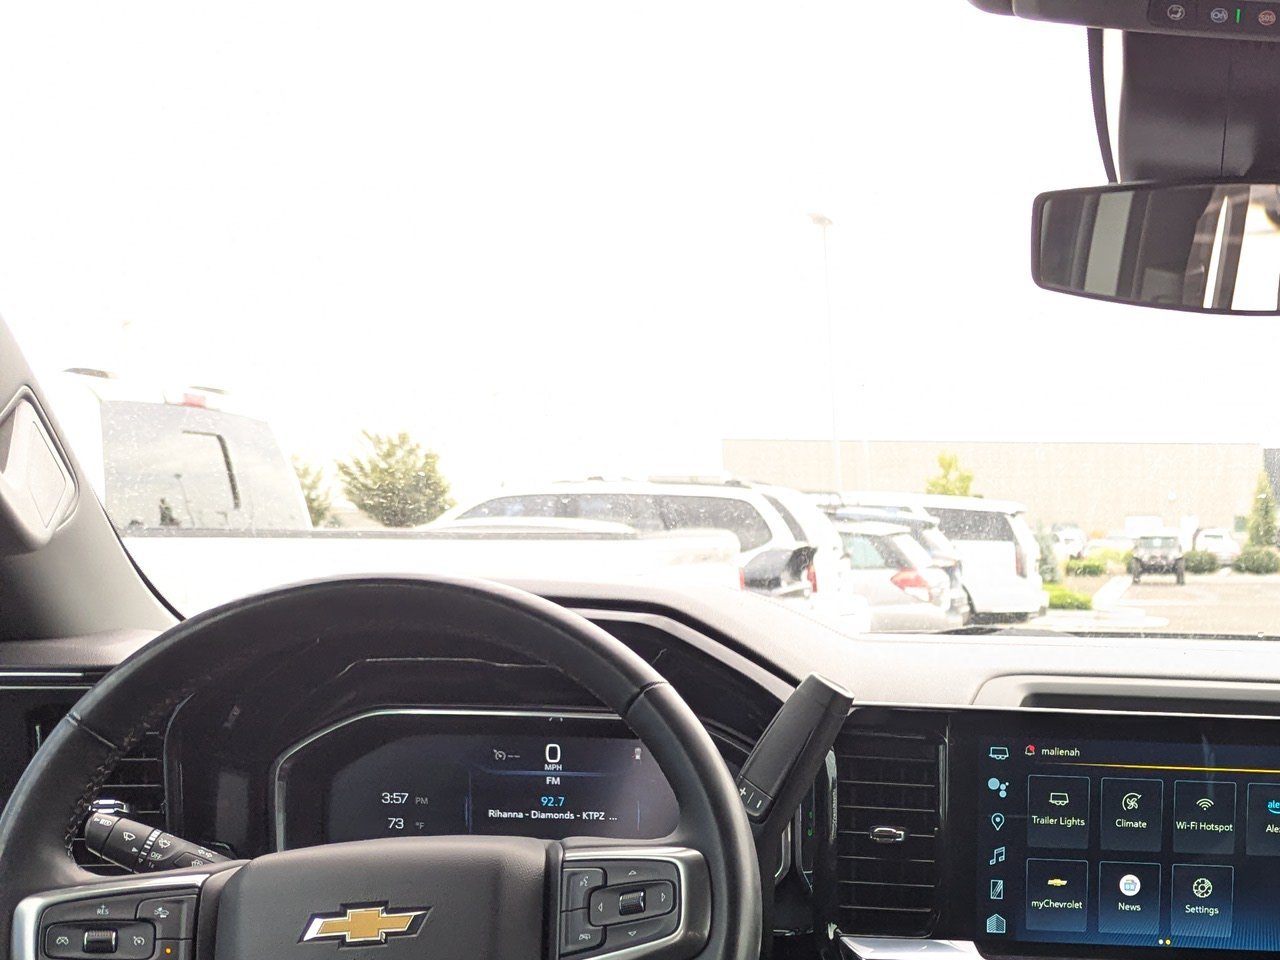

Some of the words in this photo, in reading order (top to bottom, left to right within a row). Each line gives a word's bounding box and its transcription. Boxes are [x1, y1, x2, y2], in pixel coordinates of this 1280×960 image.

[545, 743, 561, 763] 0
[1041, 747, 1080, 757] malienah
[544, 763, 562, 771] MPH
[546, 776, 561, 785] FM
[381, 792, 409, 804] 3:57
[415, 797, 428, 805] PM
[540, 796, 565, 807] 92.7
[488, 809, 523, 819] Rihanna
[531, 810, 574, 820] Diamonds
[582, 811, 605, 821] KTPZ
[387, 817, 404, 829] 73
[1031, 815, 1057, 825] Trailer
[1059, 816, 1085, 827] Lights
[1115, 818, 1147, 829] Climate
[1176, 821, 1198, 831] Wi-Fi
[1199, 822, 1233, 833] Hotspot
[151, 851, 162, 860] OFF
[1031, 899, 1082, 910] myChevrolet
[1118, 902, 1141, 912] News
[1185, 905, 1219, 916] Settings
